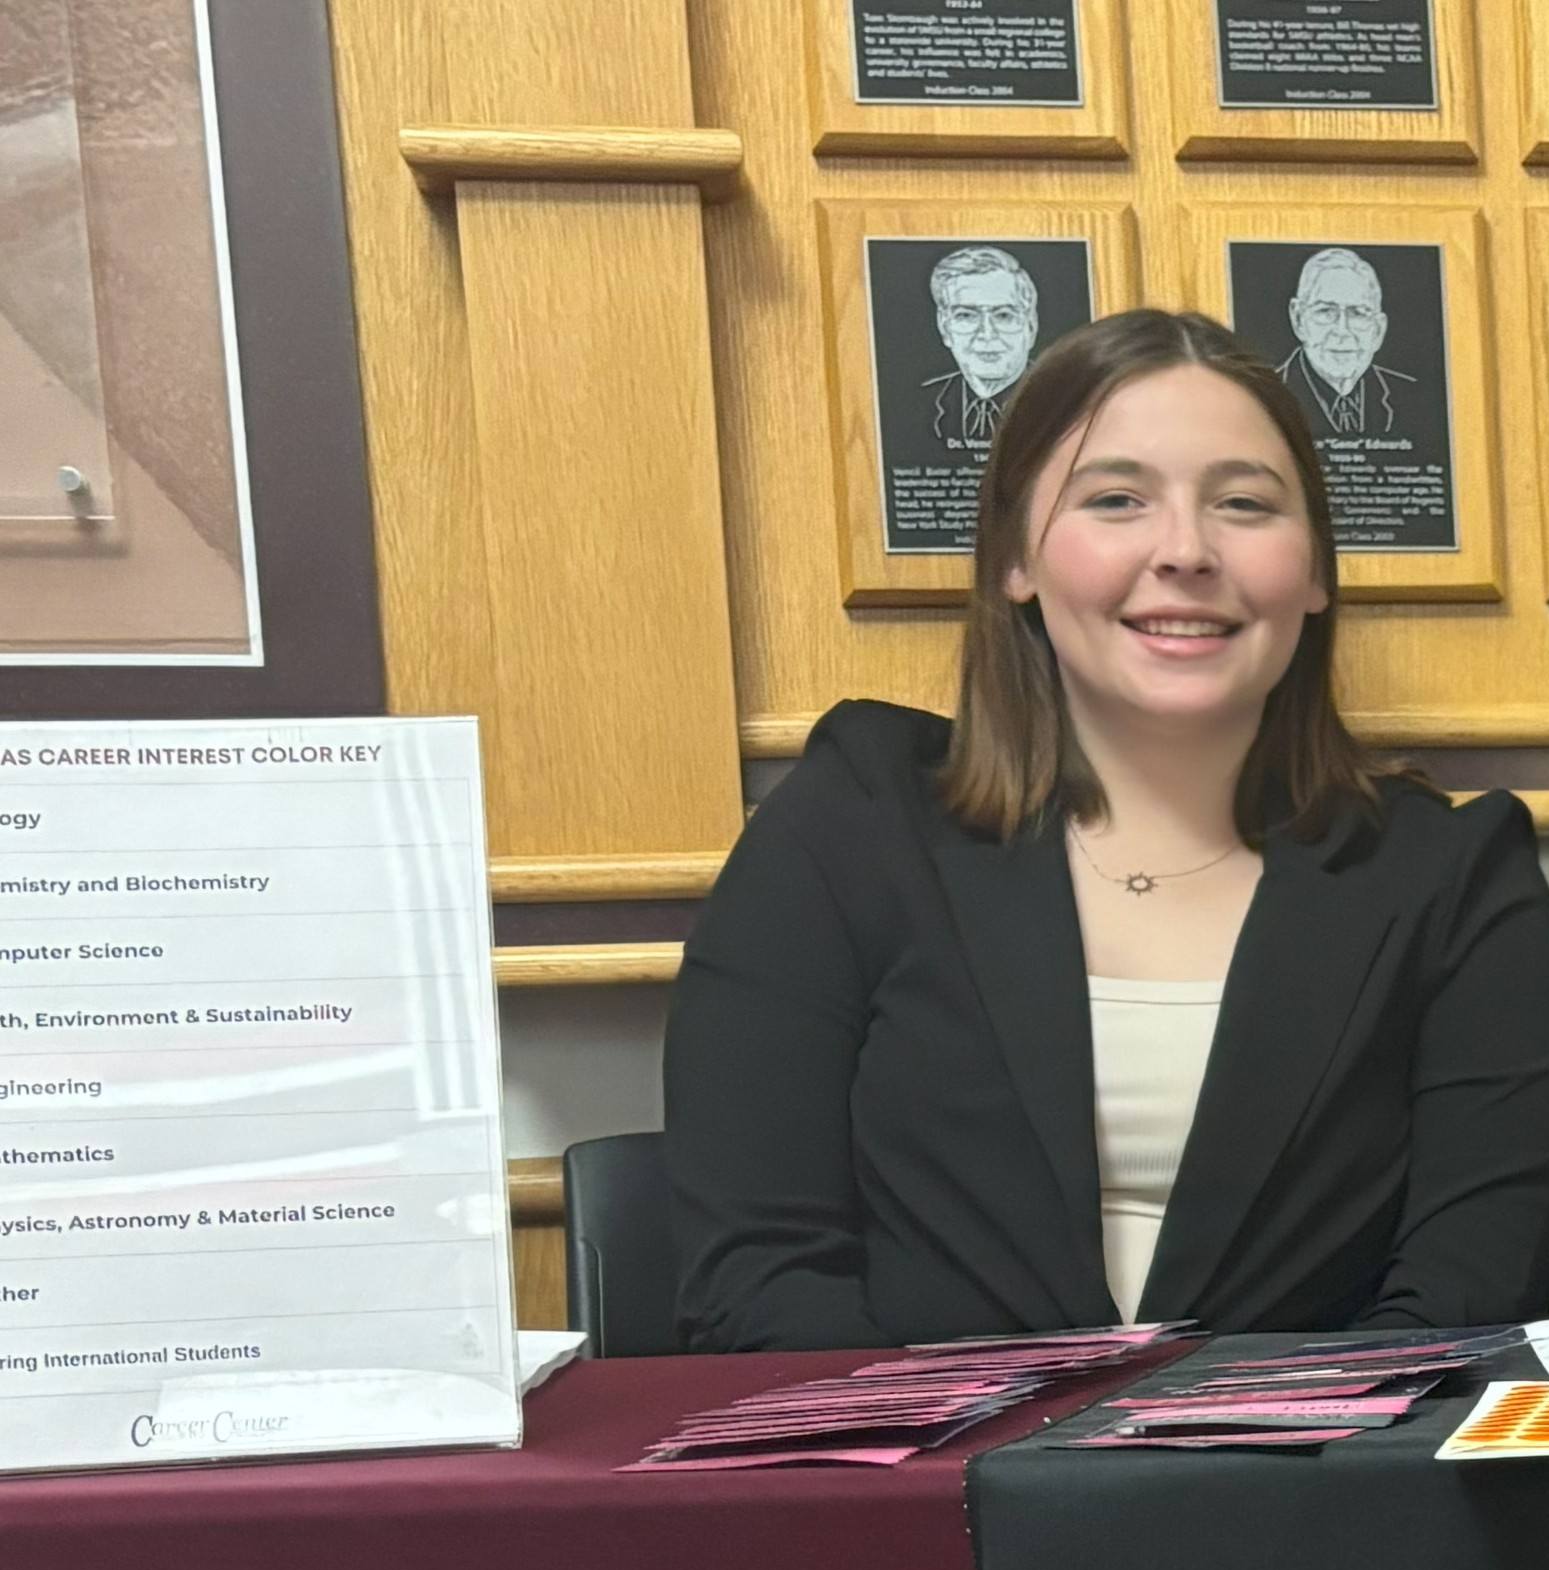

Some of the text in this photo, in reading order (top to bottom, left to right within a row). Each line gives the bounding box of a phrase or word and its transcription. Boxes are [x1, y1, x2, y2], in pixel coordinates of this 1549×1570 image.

[947, 438, 964, 448] Dr.
[38, 748, 131, 766] CAREER
[137, 747, 245, 765] INTEREST
[251, 746, 333, 764] COLOR
[339, 744, 382, 763] KEY
[77, 876, 119, 893] and
[125, 873, 270, 893] Biochemistry
[78, 942, 164, 959] Science
[35, 1010, 179, 1028] Environment
[185, 1008, 200, 1024] &
[206, 1003, 353, 1023] Sustainability
[0, 1145, 115, 1165] thematics
[0, 1203, 395, 1237] ysics, Astronomy & Material Science
[2, 1286, 40, 1302] her
[44, 1347, 168, 1368] International
[174, 1344, 261, 1362] Students
